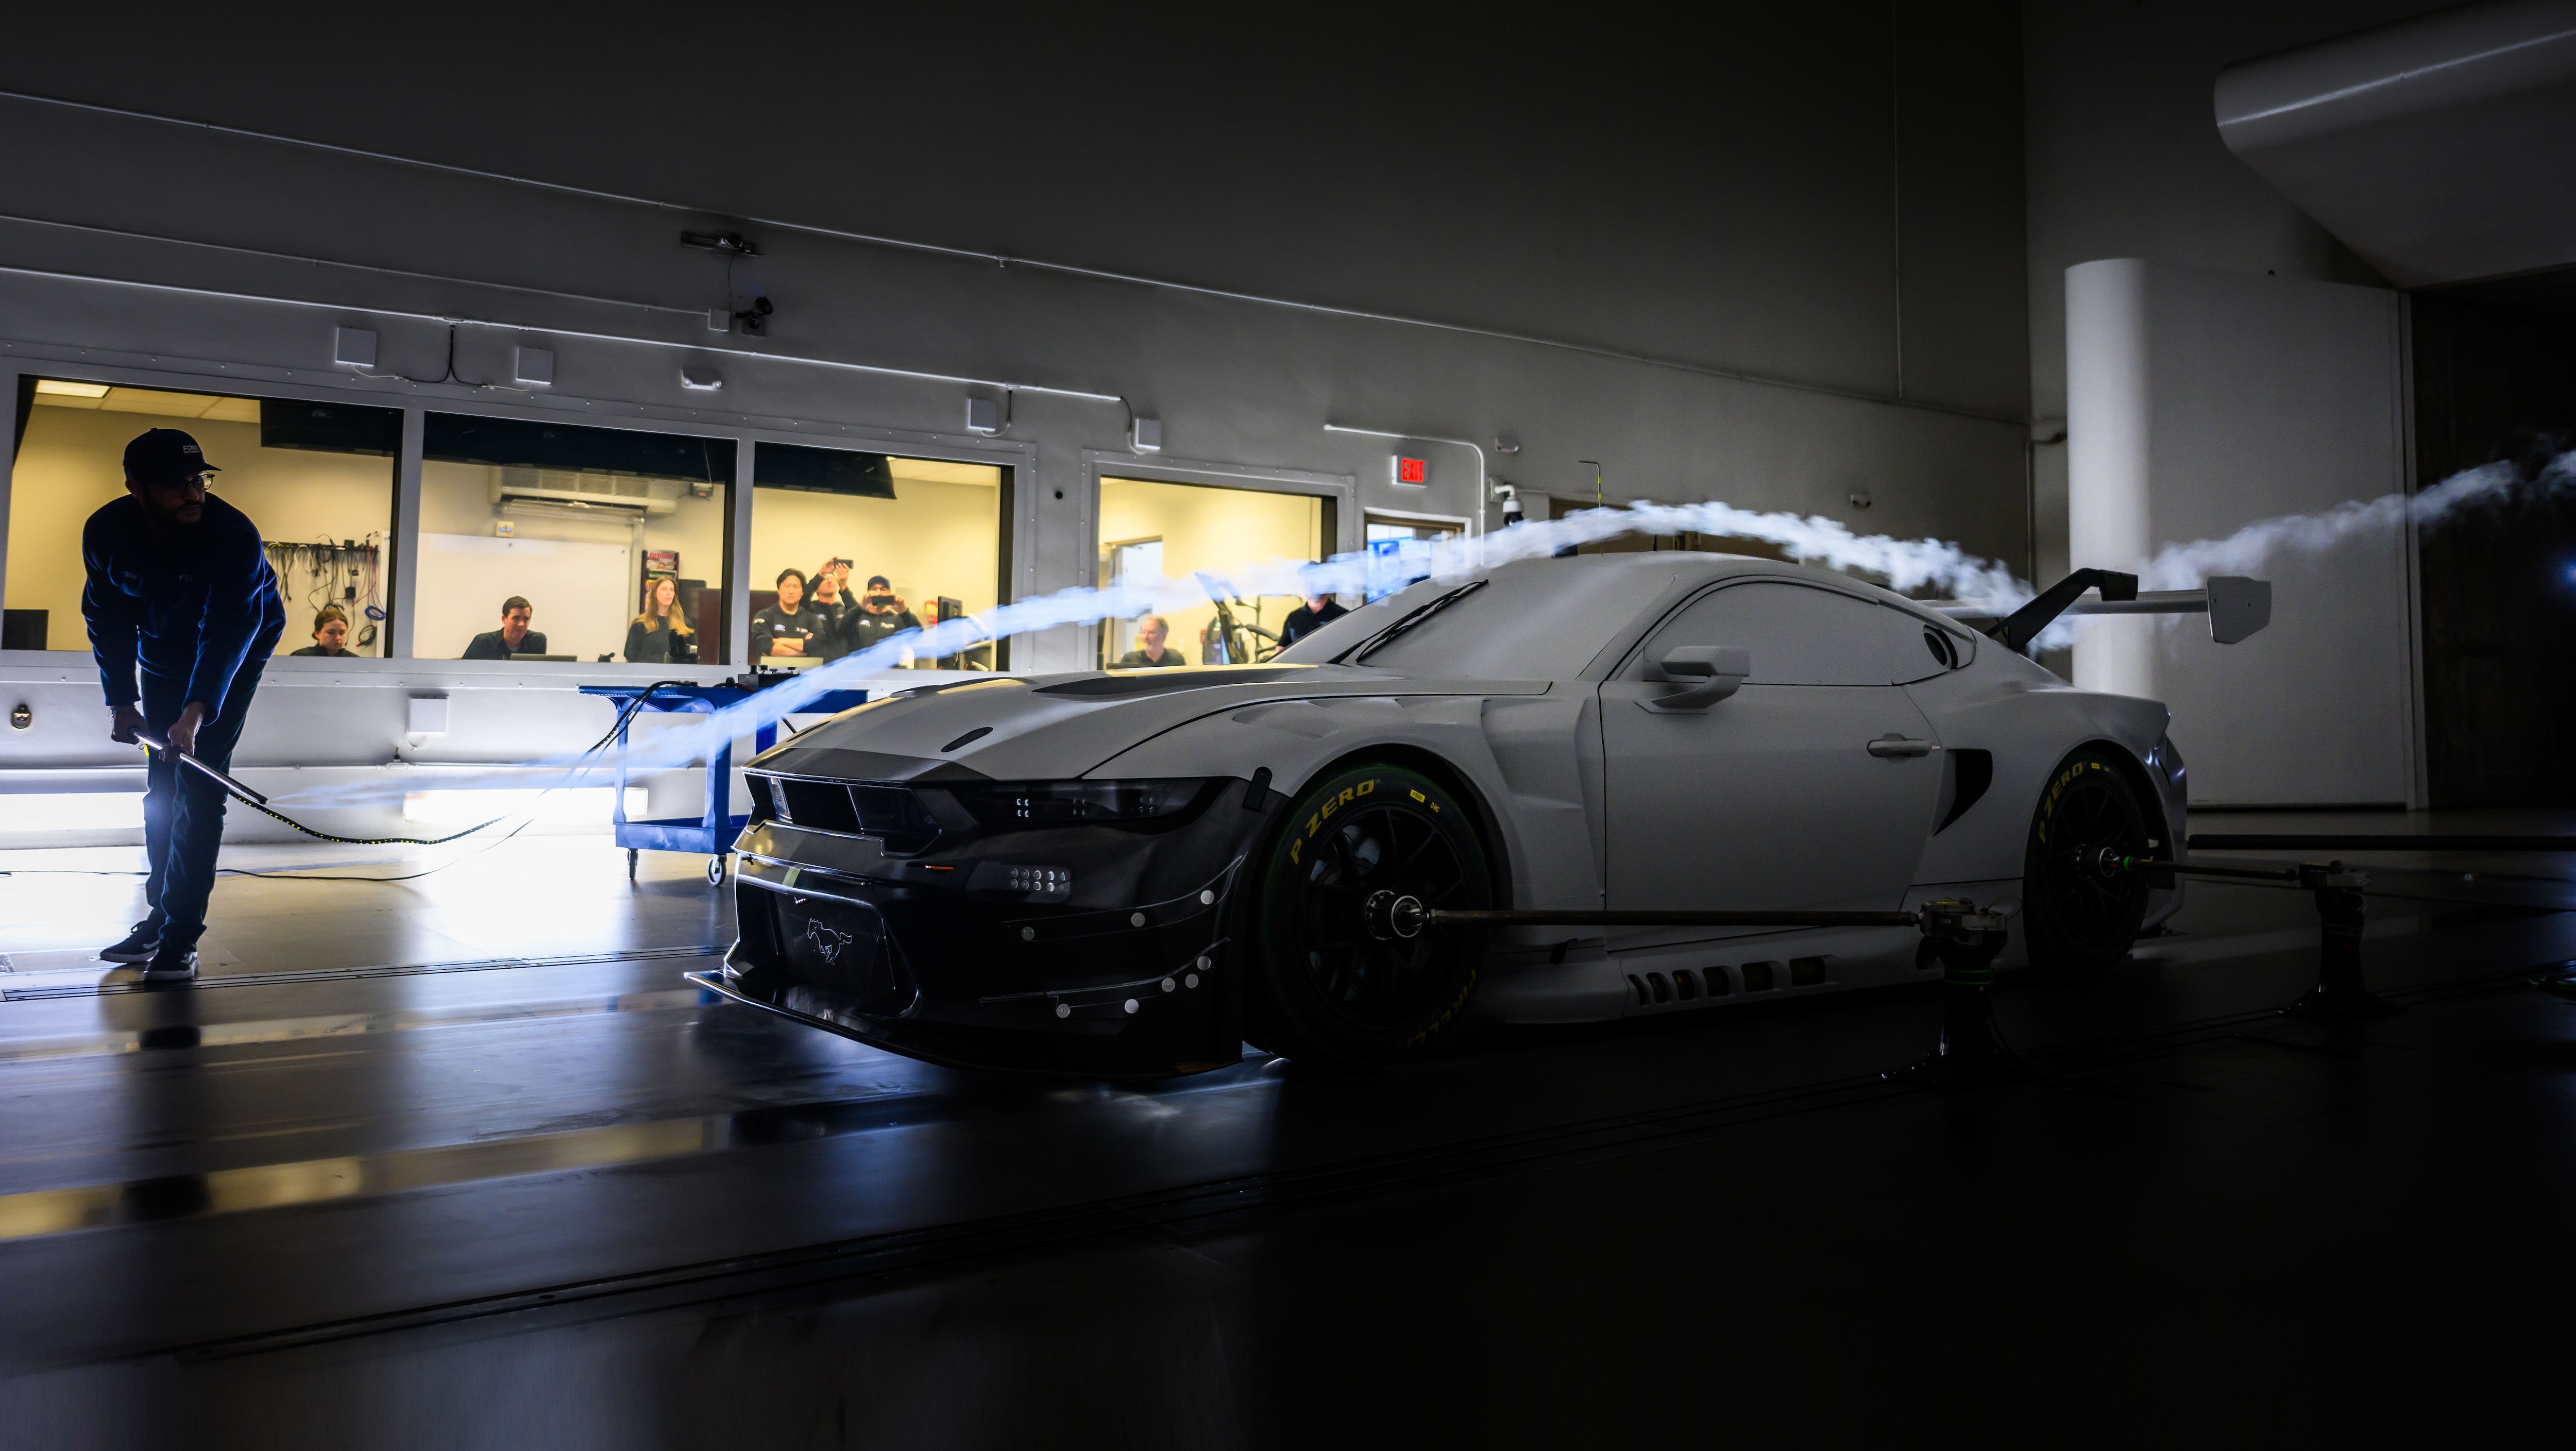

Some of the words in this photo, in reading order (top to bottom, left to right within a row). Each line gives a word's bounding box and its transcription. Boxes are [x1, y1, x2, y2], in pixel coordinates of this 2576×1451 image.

[1401, 458, 1425, 483] EXIT
[1290, 838, 1303, 865] P
[1306, 779, 1375, 838] ZERO
[1430, 802, 1440, 813] DHG
[2039, 820, 2046, 844] P
[2044, 762, 2083, 819] ZERO
